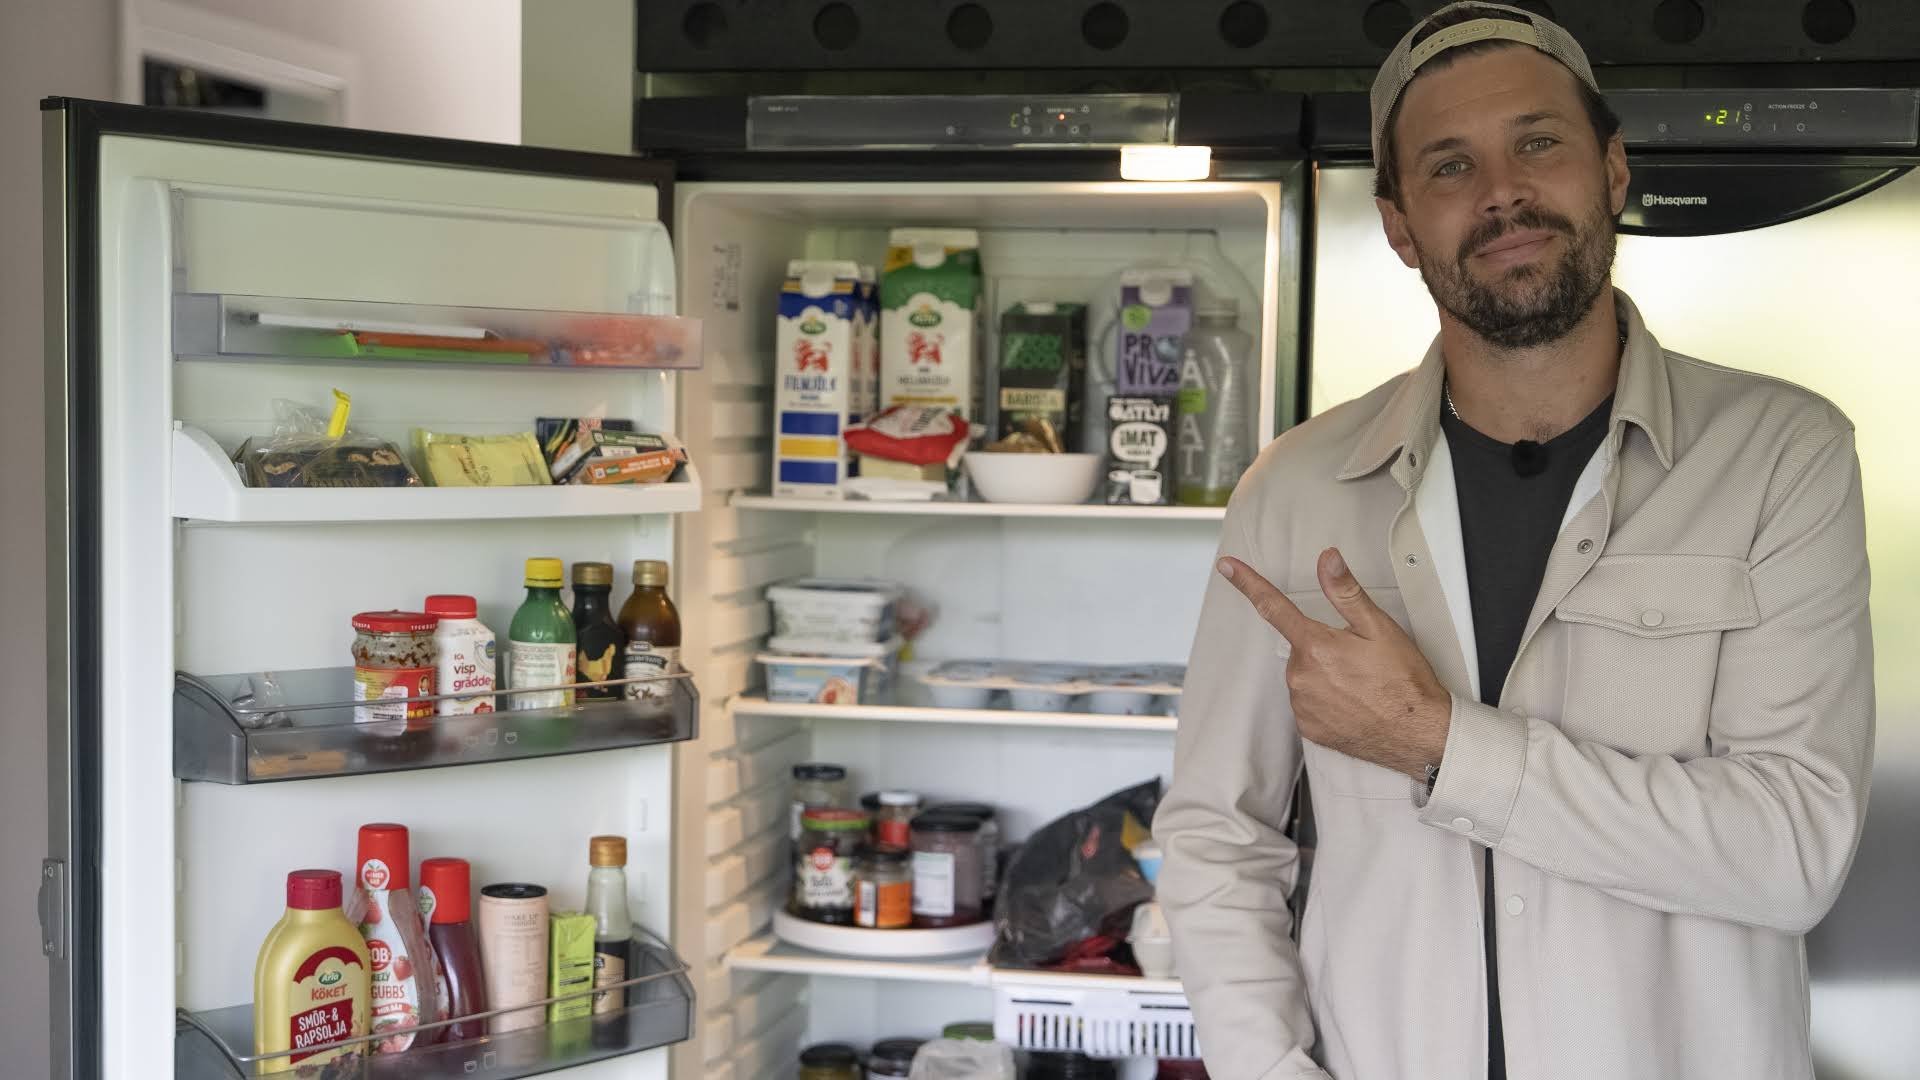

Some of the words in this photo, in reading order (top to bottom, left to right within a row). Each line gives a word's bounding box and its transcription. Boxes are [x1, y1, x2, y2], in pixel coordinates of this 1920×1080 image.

[1654, 195, 1707, 206] Husqvarna
[1109, 402, 1168, 421] OATLY!
[453, 663, 476, 677] visp
[453, 675, 491, 691] grädde
[369, 947, 389, 962] OB
[322, 972, 339, 982] Arla
[311, 984, 347, 1000] KÖKET
[298, 1010, 330, 1031] SMÖR-
[332, 1008, 338, 1021] &
[295, 1020, 347, 1048] RAPSOLJA
